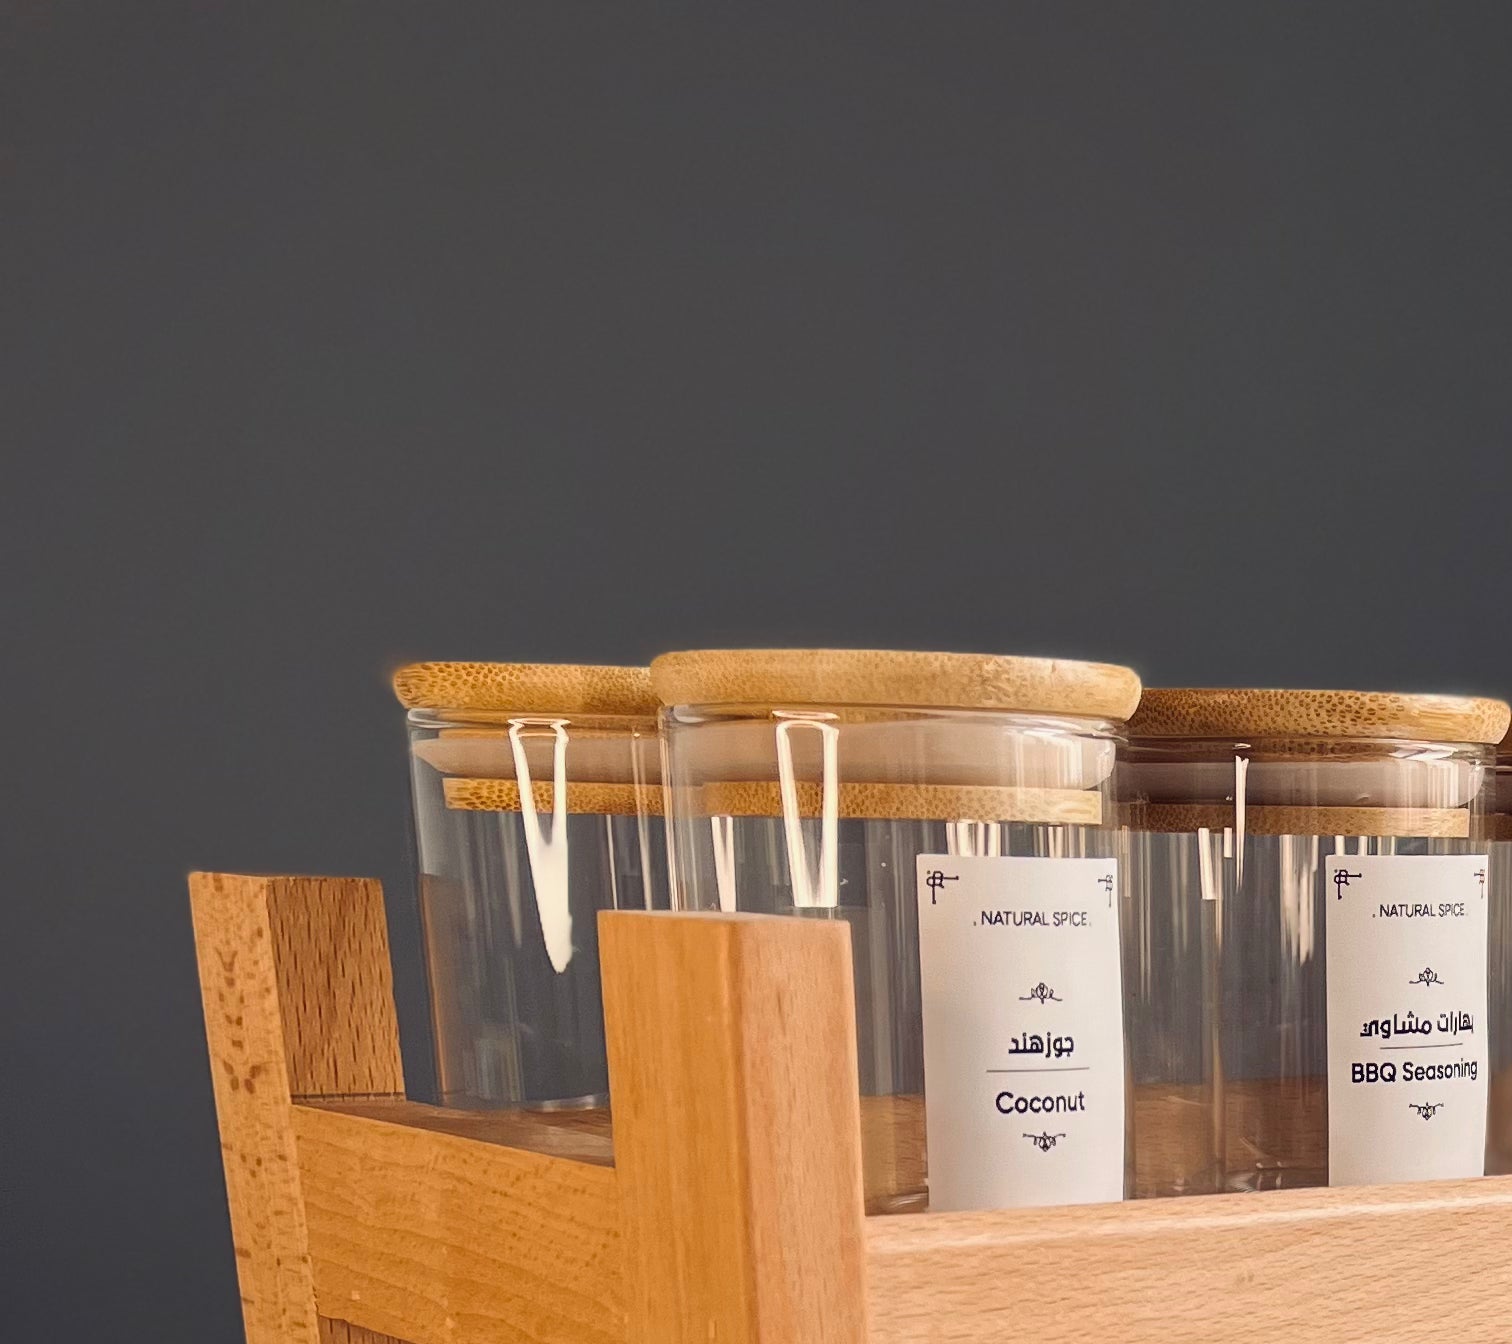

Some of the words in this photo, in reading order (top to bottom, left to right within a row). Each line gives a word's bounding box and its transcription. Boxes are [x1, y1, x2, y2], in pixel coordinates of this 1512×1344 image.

[981, 910, 1050, 927] NATURAL
[1379, 903, 1436, 918] NATURAL
[1351, 1062, 1397, 1083] BBQ
[1402, 1058, 1478, 1081] Seasoning
[995, 1091, 1085, 1114] Coconut
